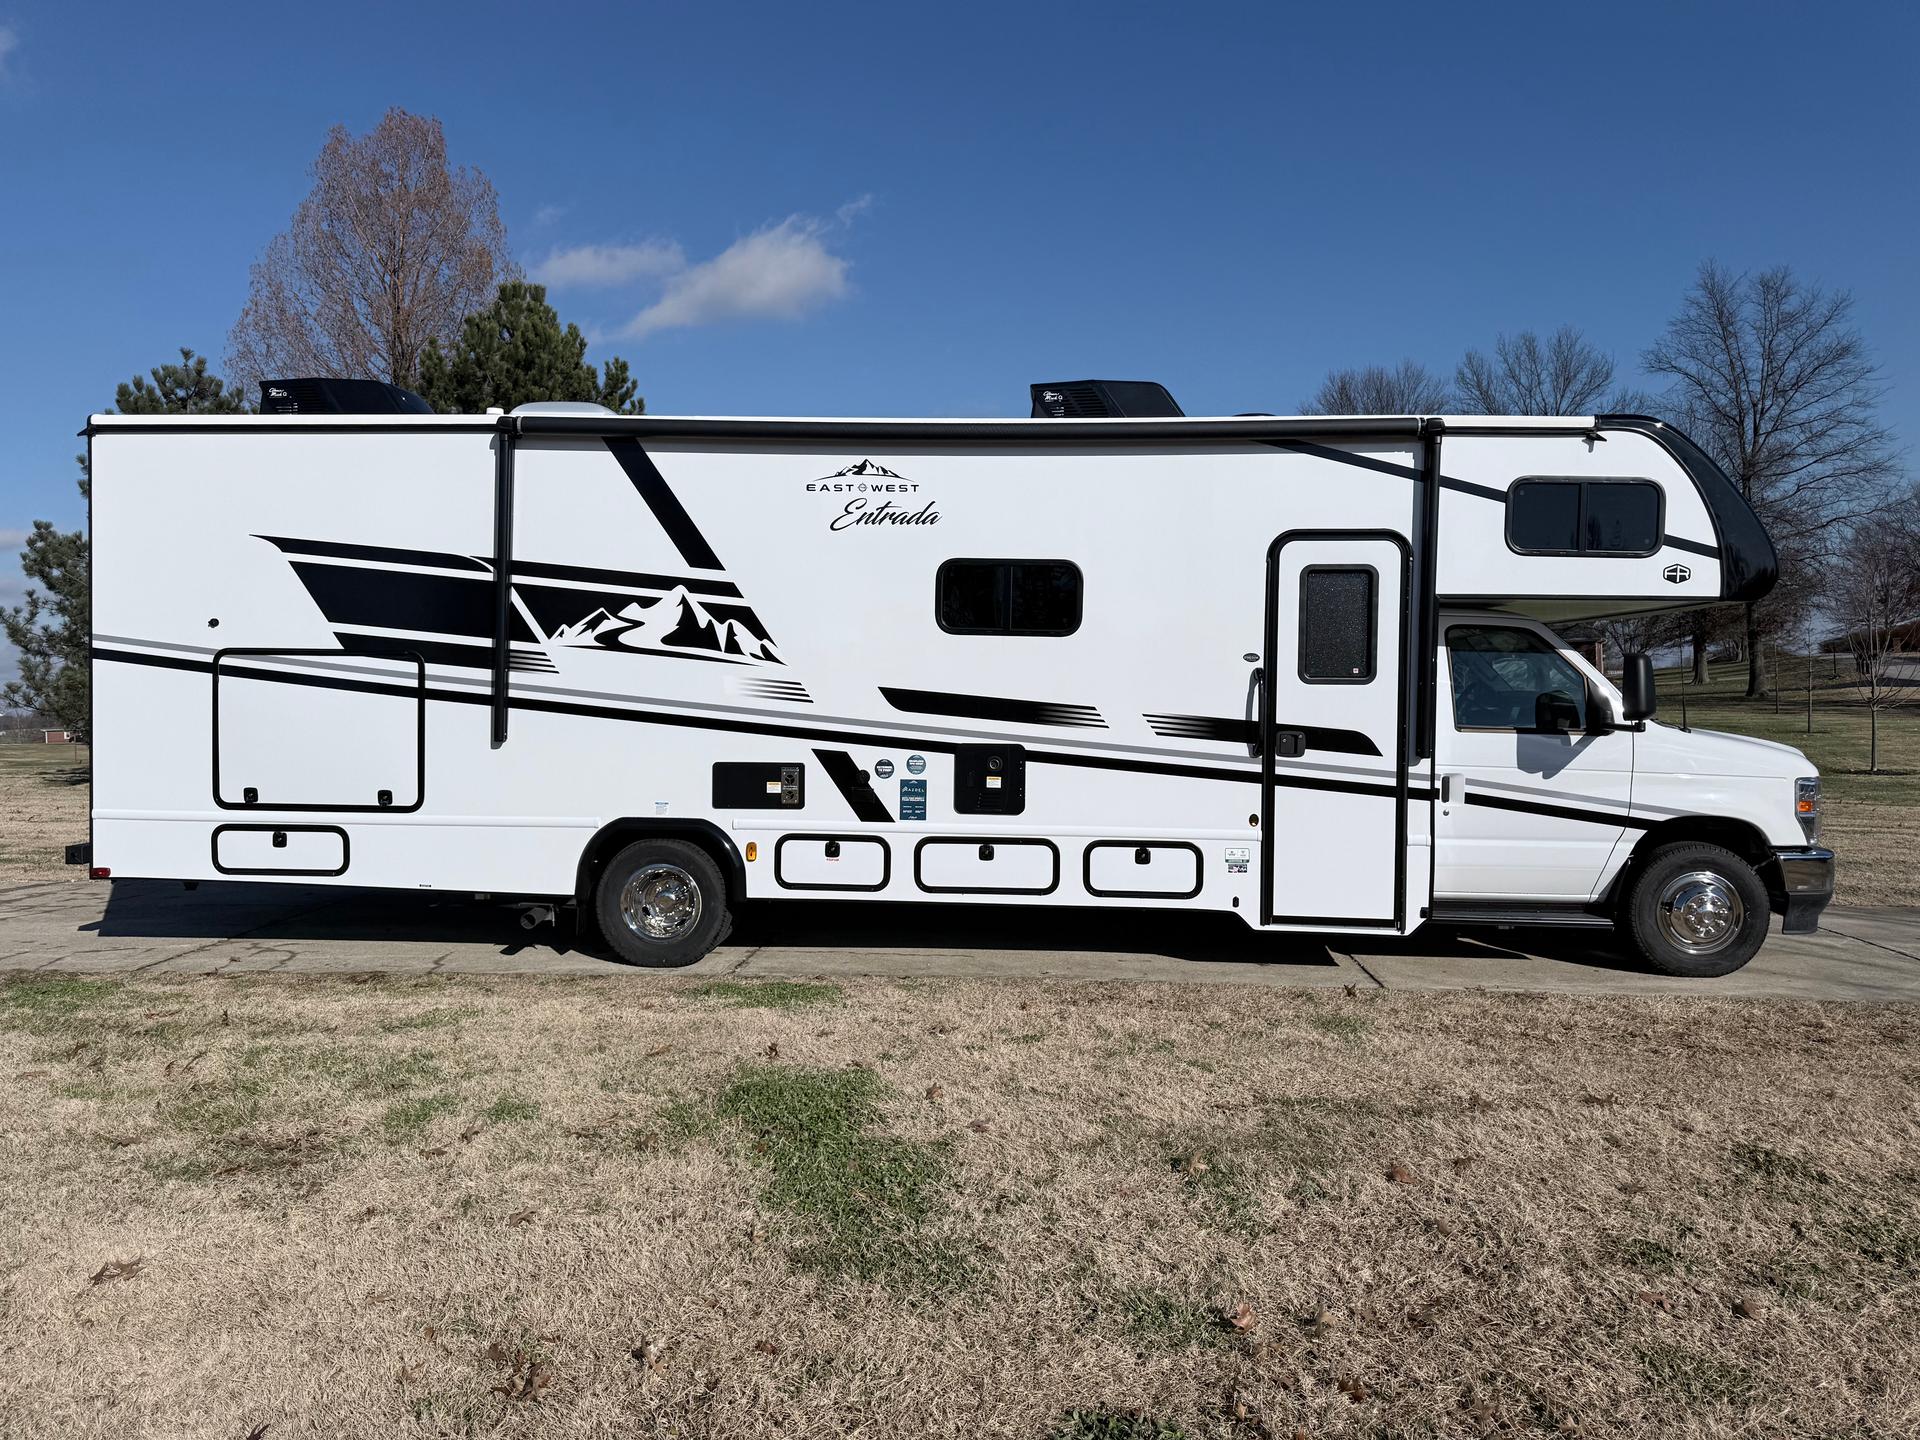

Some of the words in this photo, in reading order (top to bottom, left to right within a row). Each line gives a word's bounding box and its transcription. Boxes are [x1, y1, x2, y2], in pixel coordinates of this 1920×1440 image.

[806, 484, 854, 492] EAST
[871, 484, 920, 493] WEST
[829, 497, 943, 532] Entrada
